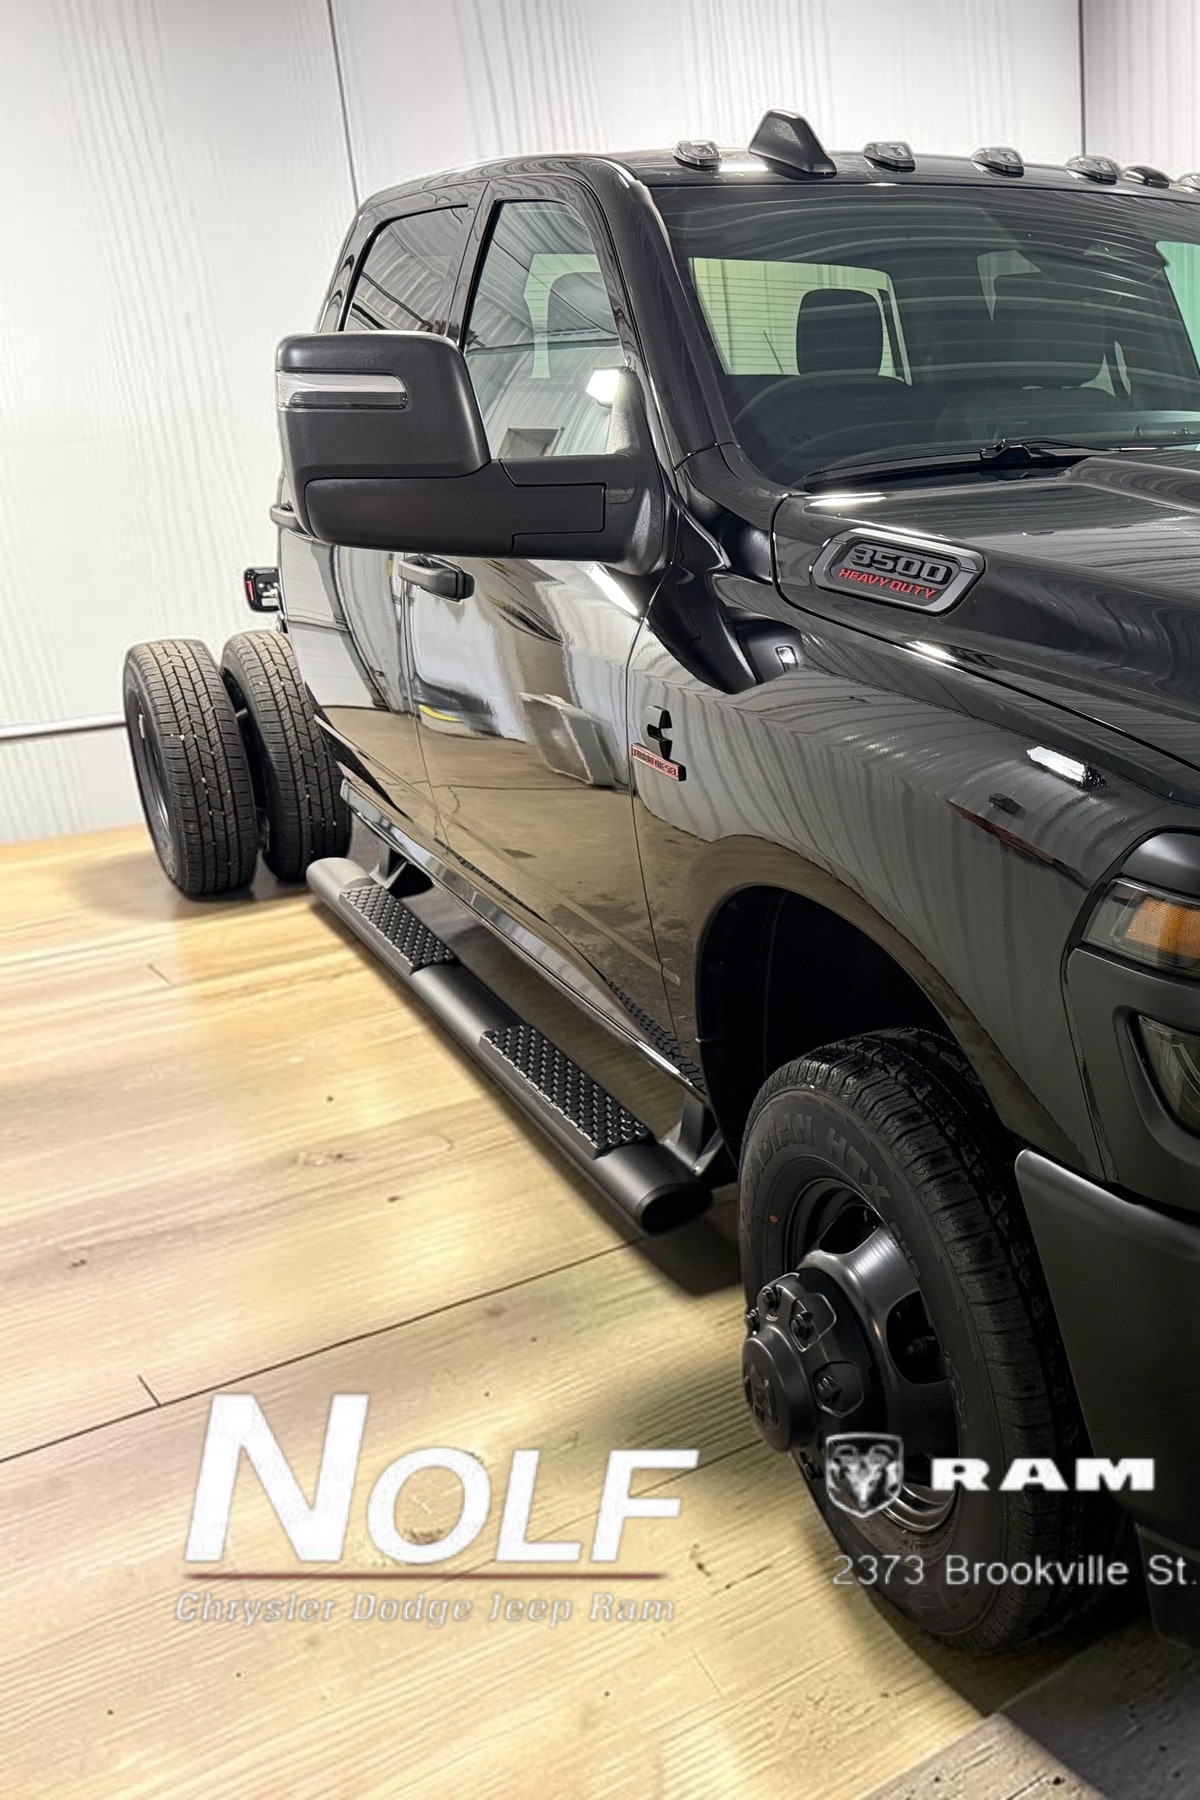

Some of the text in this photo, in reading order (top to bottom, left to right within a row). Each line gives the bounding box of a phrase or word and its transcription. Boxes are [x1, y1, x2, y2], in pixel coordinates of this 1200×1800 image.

[838, 568, 939, 599] HEAVY DUTY
[849, 546, 953, 586] 3500
